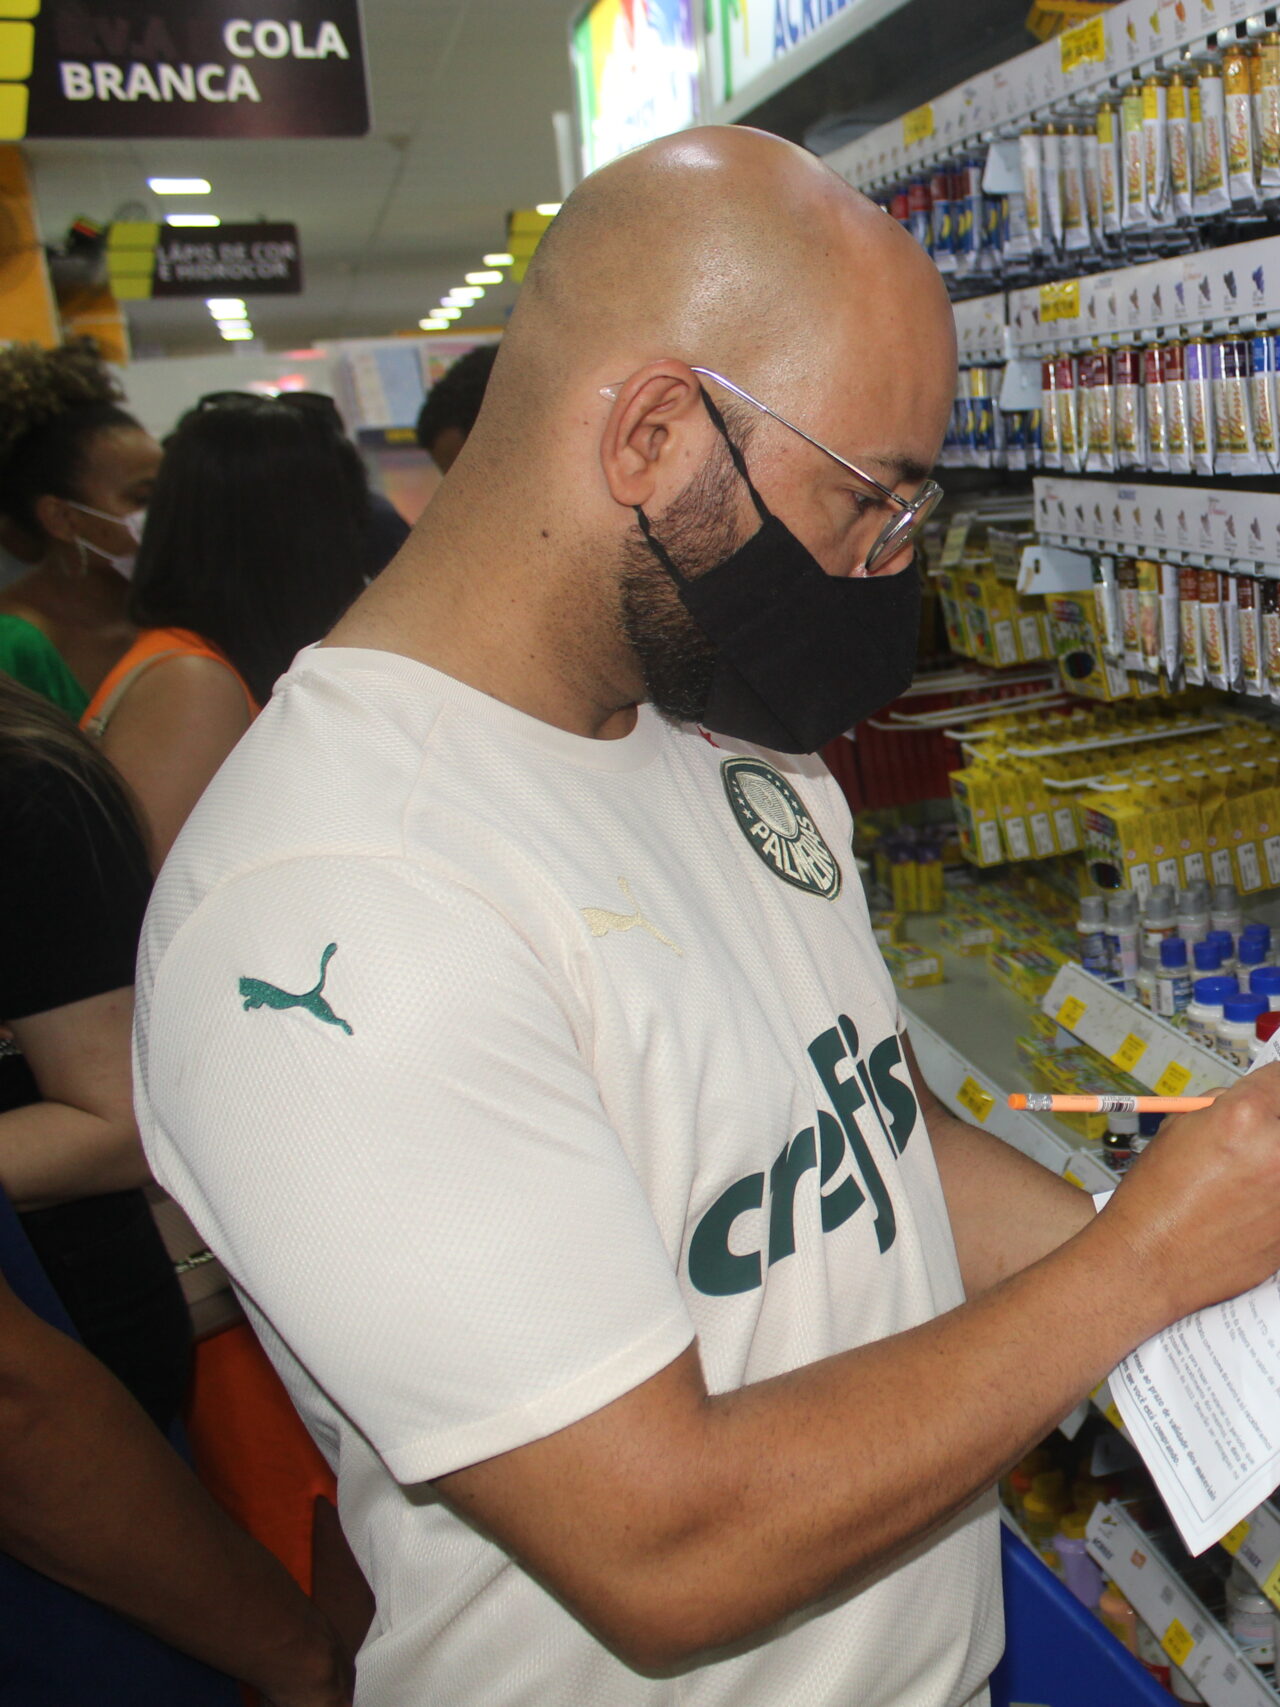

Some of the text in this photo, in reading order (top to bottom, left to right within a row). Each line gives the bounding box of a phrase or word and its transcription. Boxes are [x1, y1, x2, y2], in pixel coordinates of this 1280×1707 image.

[223, 18, 350, 60] COLA
[59, 61, 262, 102] BRANCA
[688, 1013, 918, 1297] crefis
